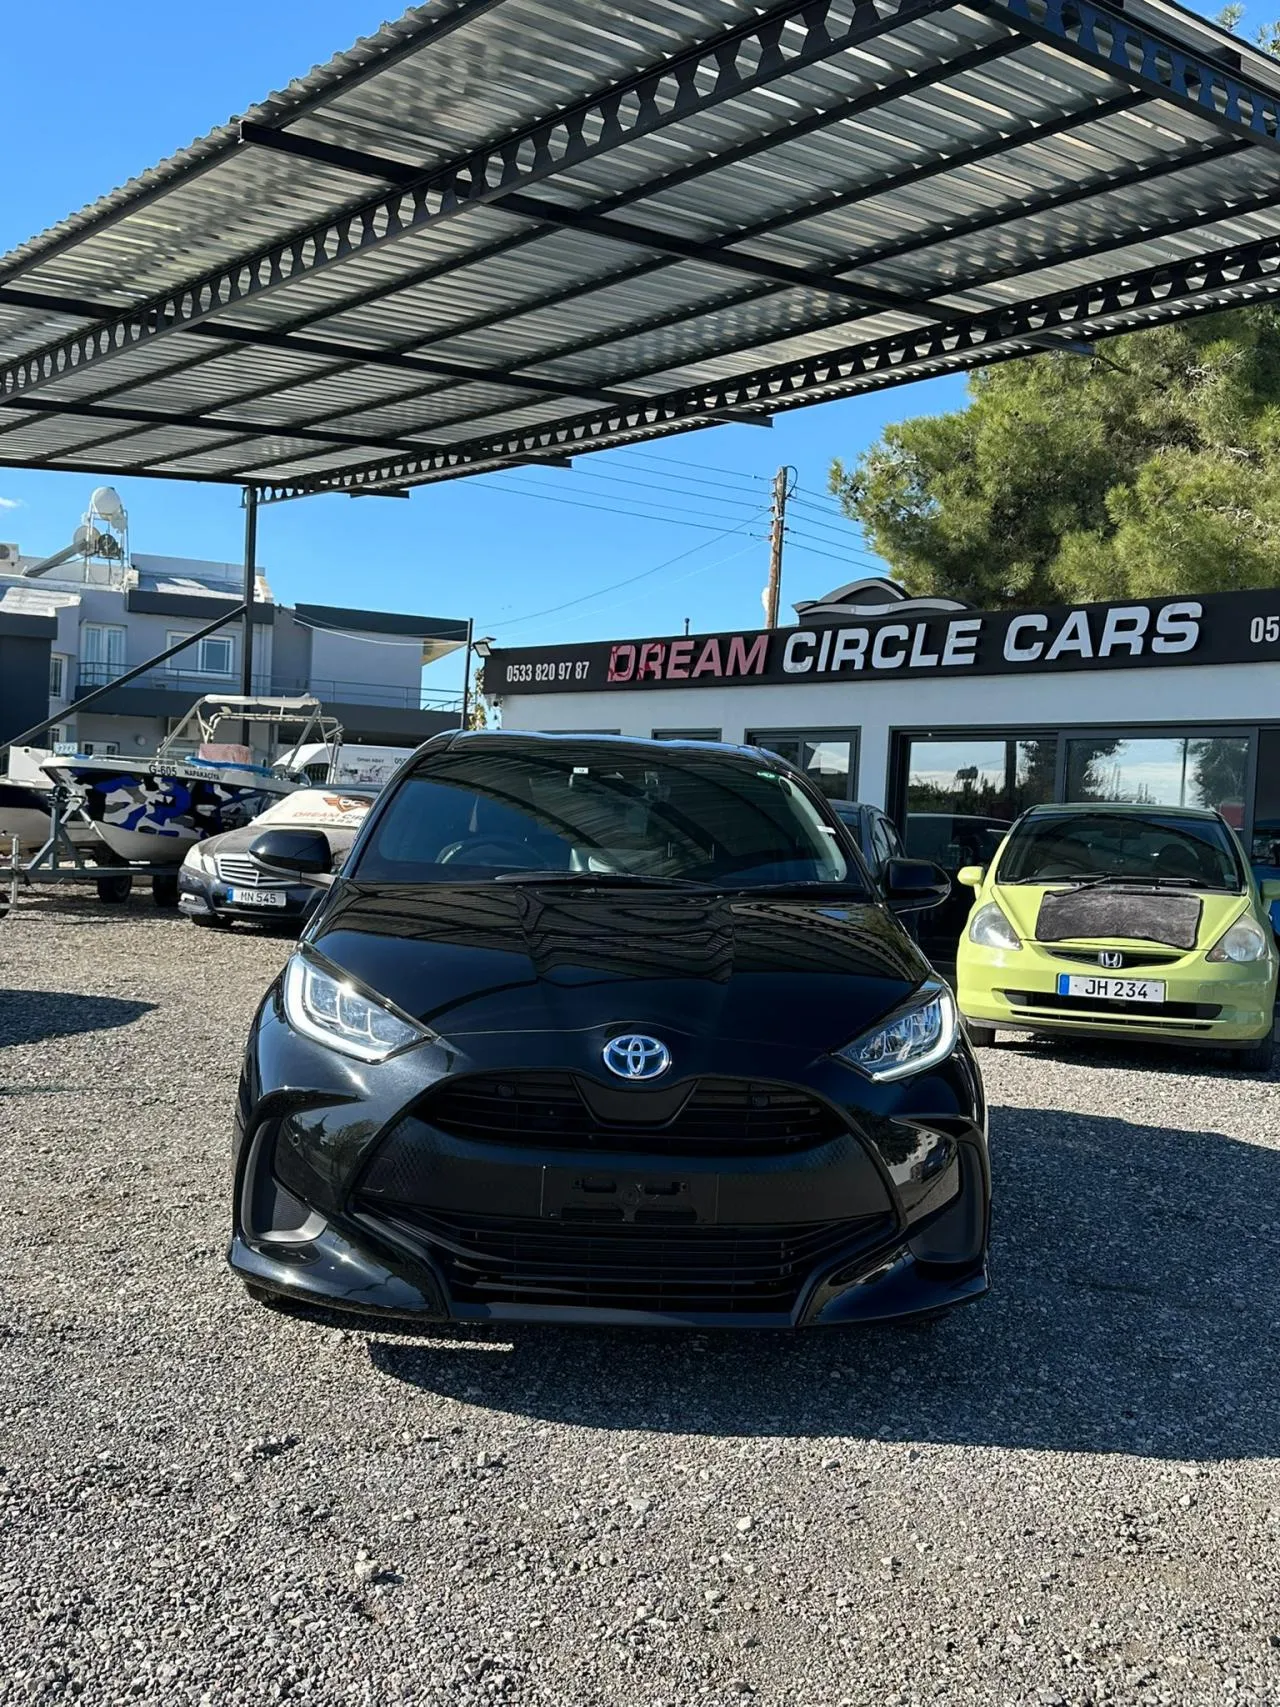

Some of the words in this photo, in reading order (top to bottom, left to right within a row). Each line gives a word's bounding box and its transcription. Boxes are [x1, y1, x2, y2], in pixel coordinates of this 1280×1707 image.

[1250, 616, 1280, 643] 05
[607, 634, 769, 682] DREAM
[783, 618, 983, 674] CIRCLE
[1003, 602, 1203, 662] CARS
[506, 664, 533, 682] 0533
[535, 663, 556, 681] 820
[558, 662, 573, 680] 97
[575, 661, 590, 680] 87
[148, 764, 178, 776] G-605
[240, 891, 255, 902] MN
[256, 893, 276, 904] 545
[1085, 979, 1108, 996] JH
[1113, 981, 1148, 999] 234
